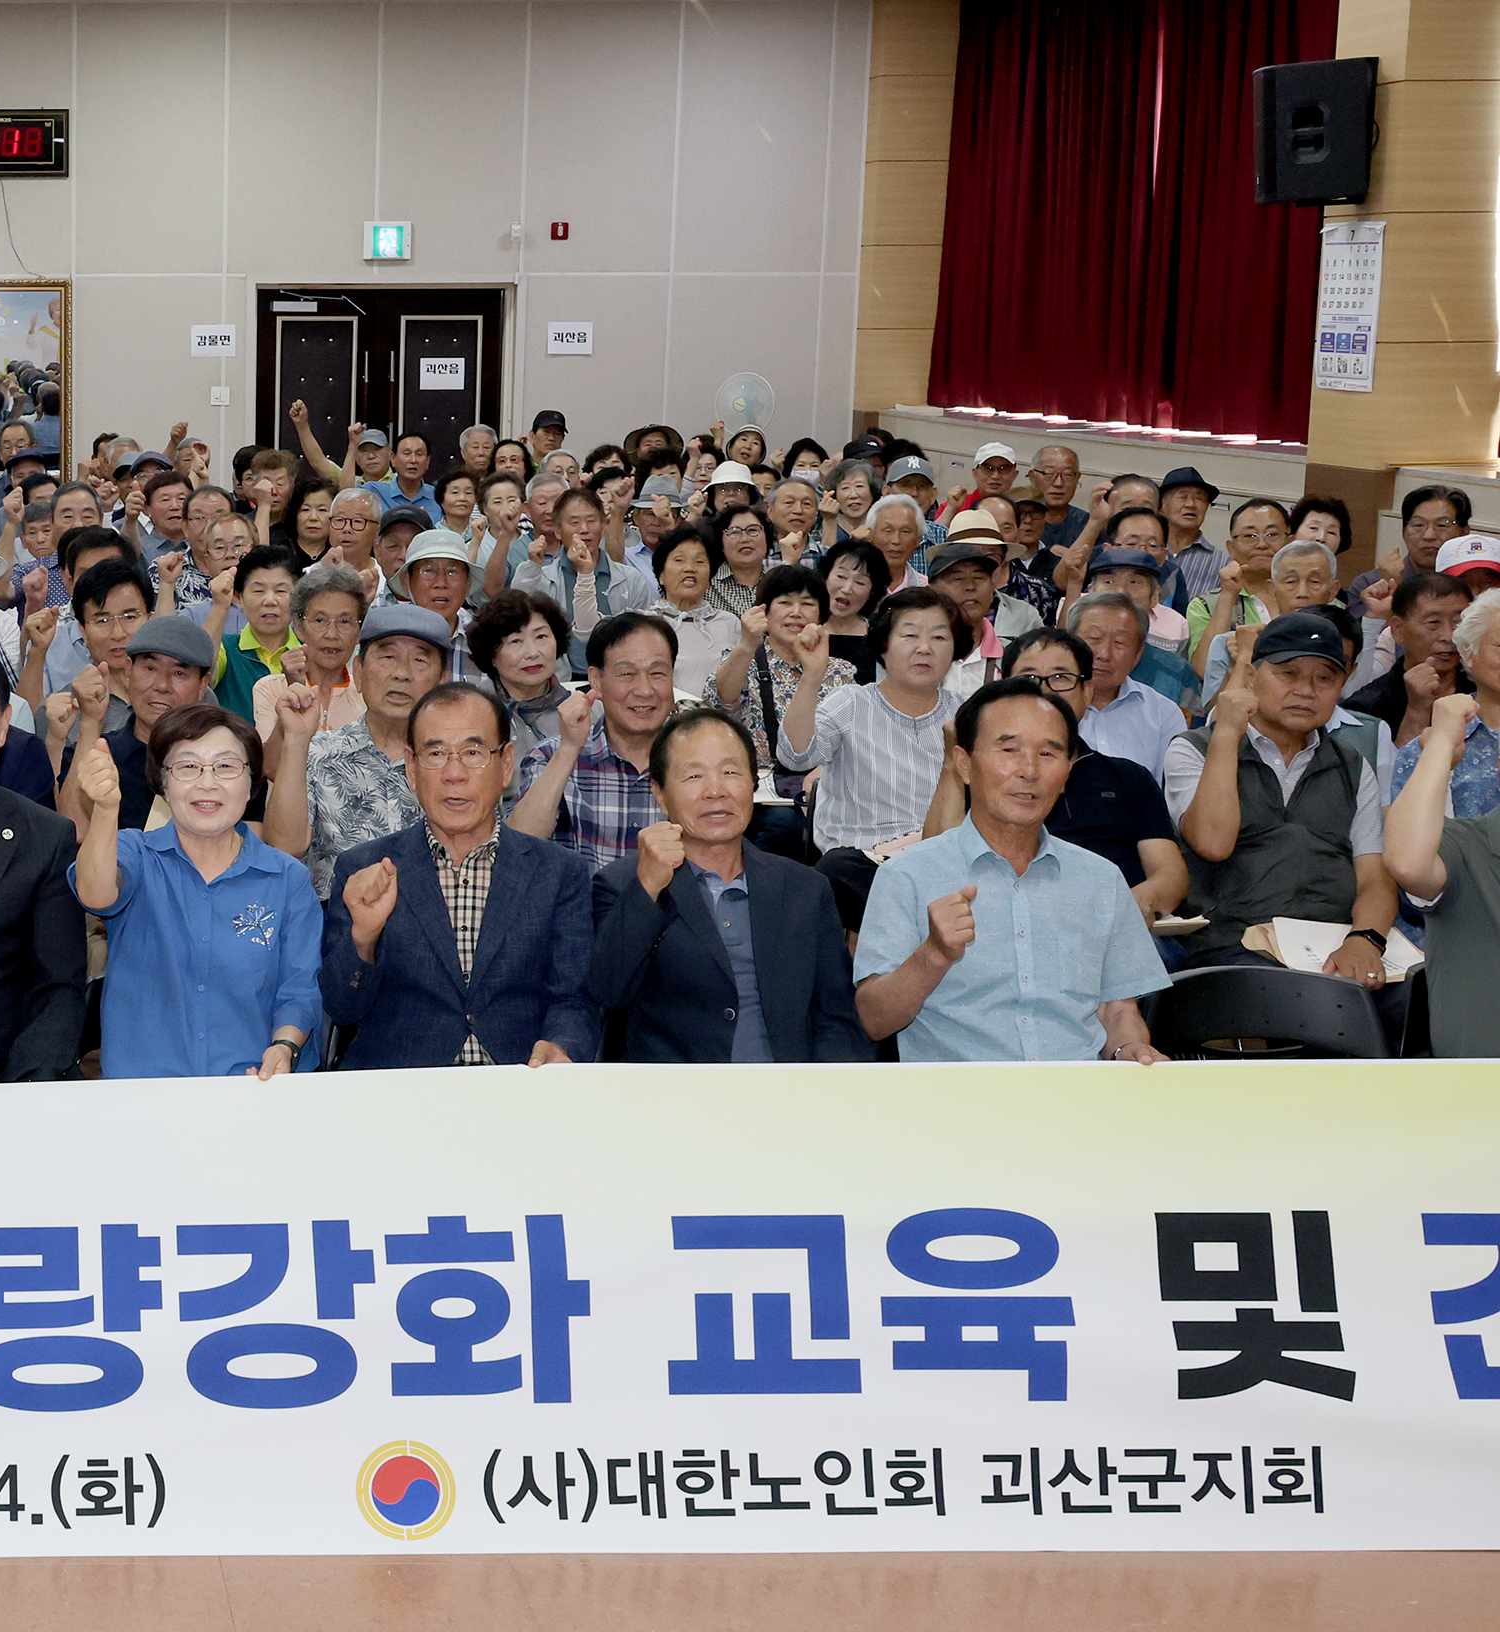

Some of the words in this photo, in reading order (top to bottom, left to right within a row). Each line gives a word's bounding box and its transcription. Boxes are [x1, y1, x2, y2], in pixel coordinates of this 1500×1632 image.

[196, 335, 230, 346] 감물면
[553, 331, 588, 343] 괴산읍
[425, 363, 459, 375] 괴산읍
[907, 456, 921, 469] NY
[668, 1207, 1076, 1402] 교육
[1154, 1210, 1357, 1402] 및
[483, 1446, 947, 1524] (사)대한노인회
[980, 1445, 1325, 1516] 괴산군지회
